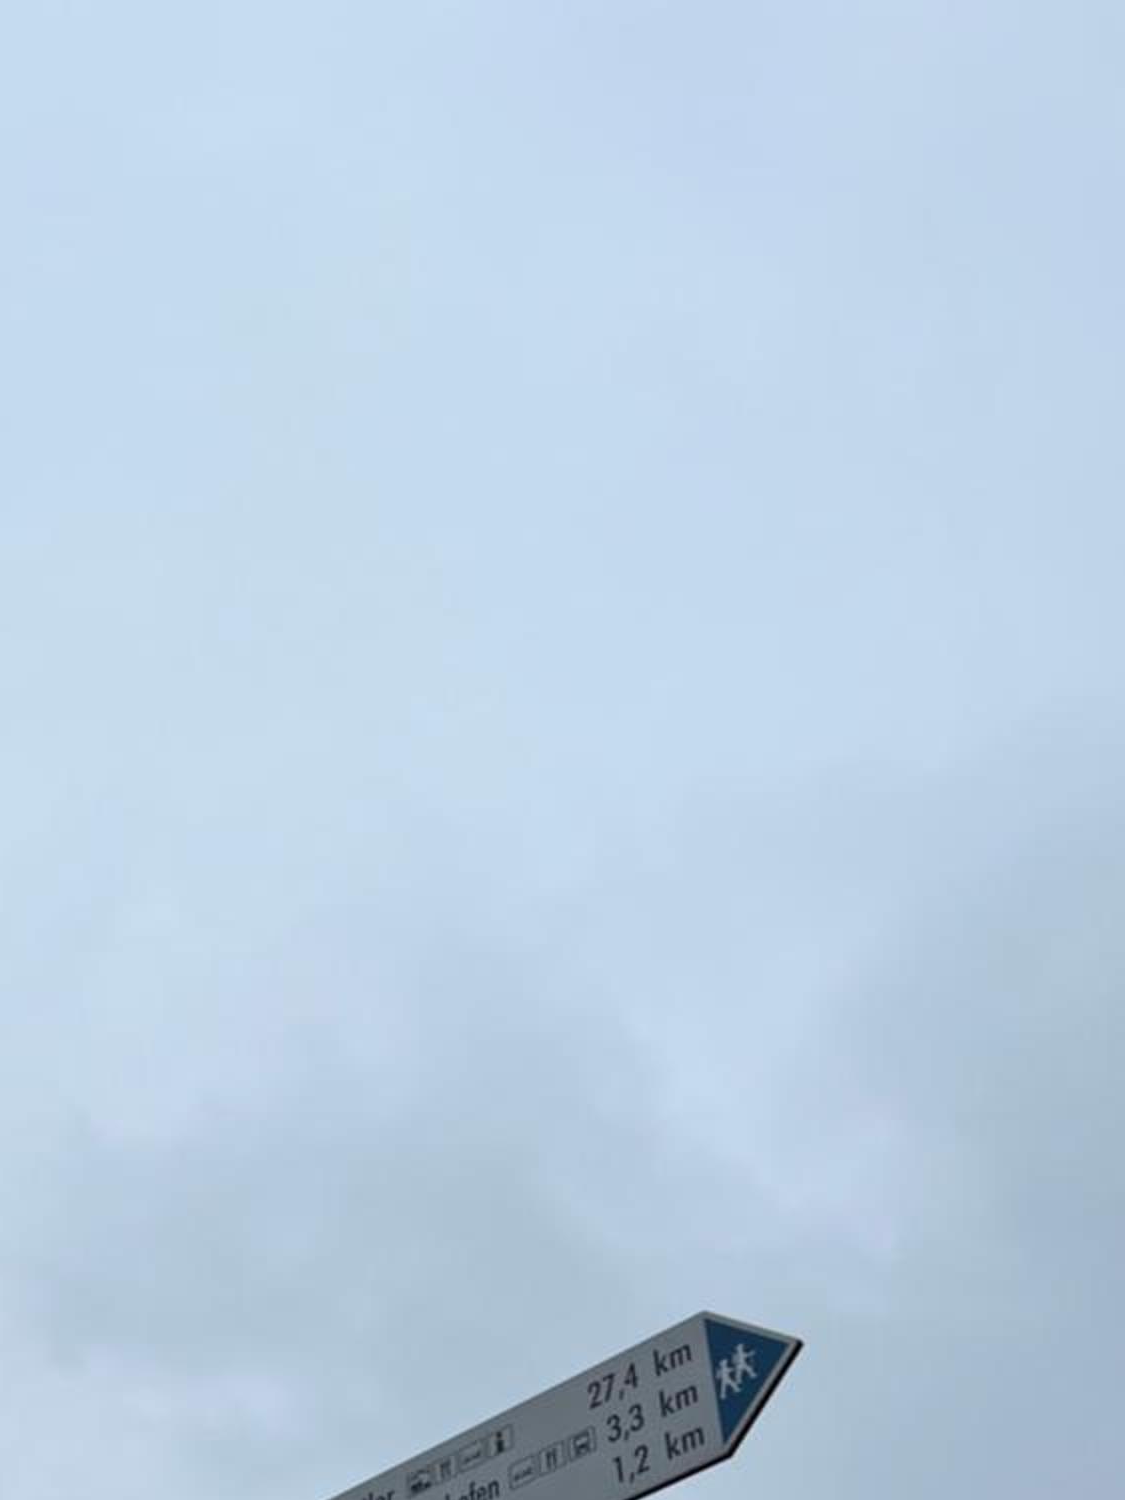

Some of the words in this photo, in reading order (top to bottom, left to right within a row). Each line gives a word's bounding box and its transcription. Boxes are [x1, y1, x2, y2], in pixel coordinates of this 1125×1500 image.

[587, 1362, 638, 1410] 27,4
[653, 1344, 692, 1376] km
[607, 1404, 644, 1443] 3,3
[659, 1385, 698, 1418] km
[613, 1444, 650, 1484] 1,2
[664, 1427, 704, 1460] km
